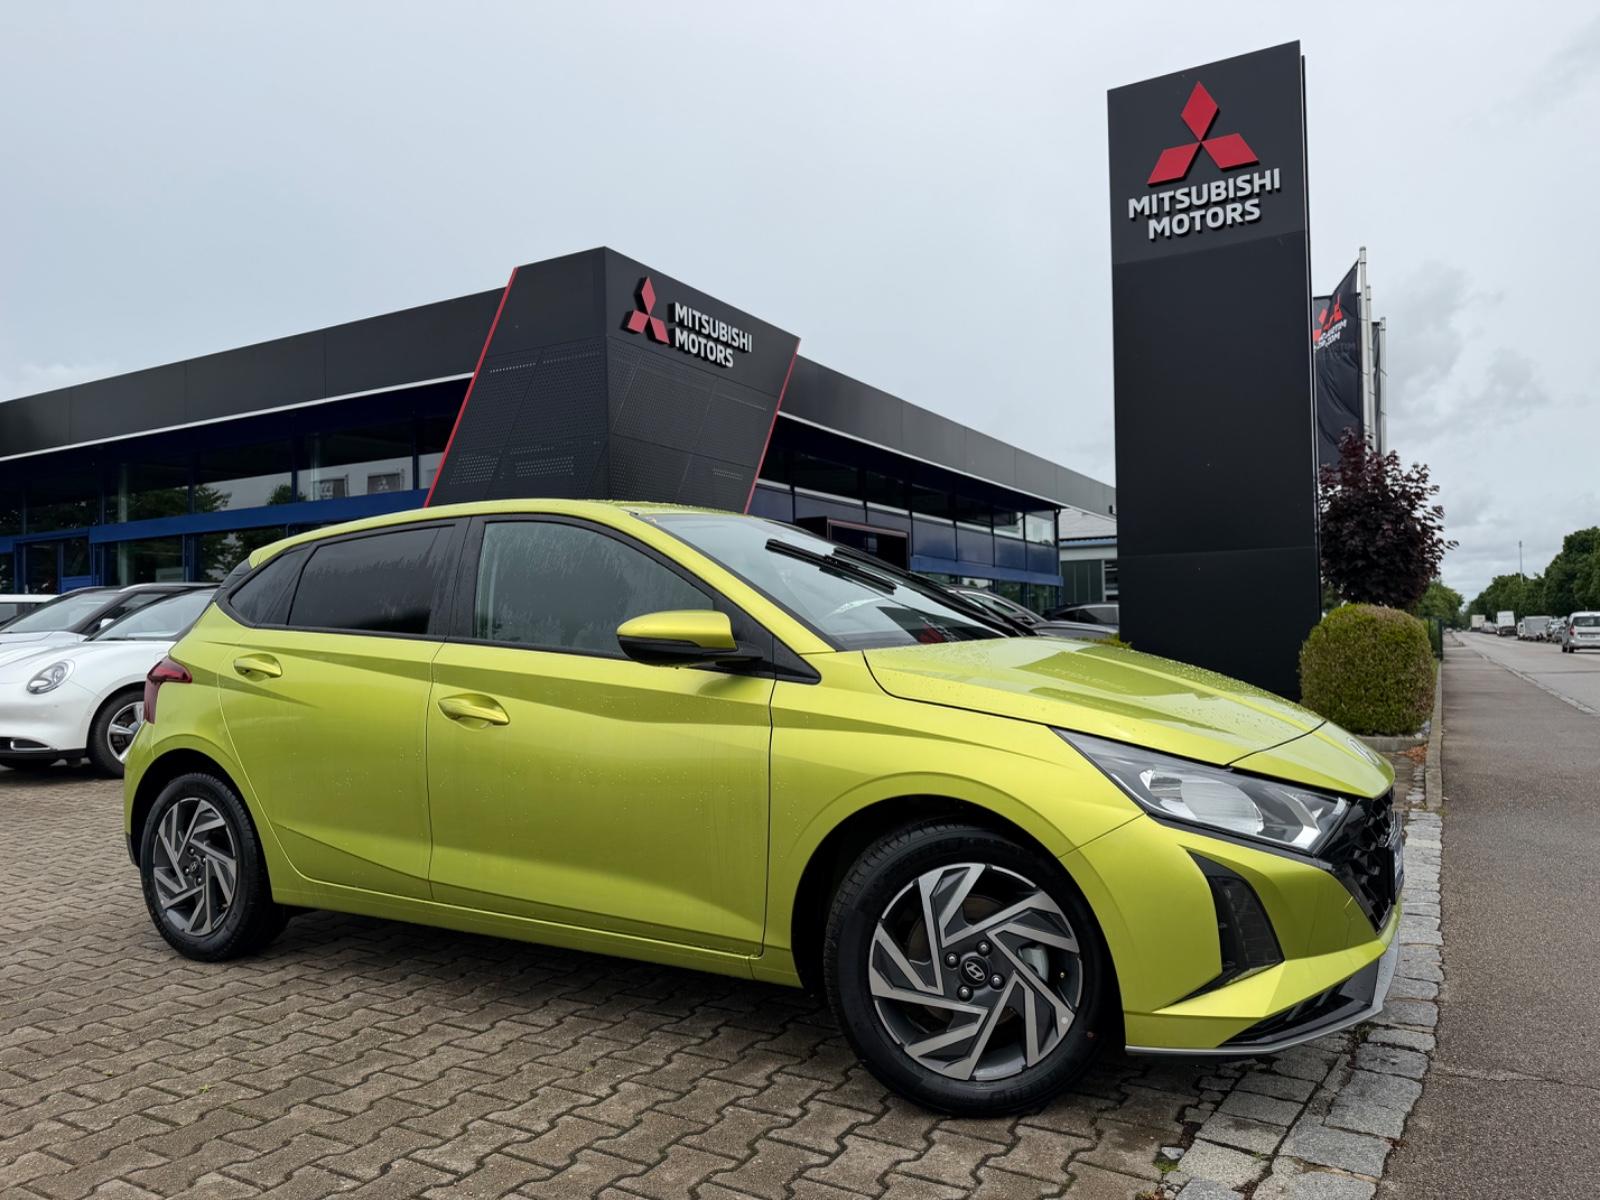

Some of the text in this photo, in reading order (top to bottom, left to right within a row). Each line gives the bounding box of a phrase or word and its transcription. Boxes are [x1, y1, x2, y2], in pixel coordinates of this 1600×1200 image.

[1128, 168, 1281, 219] MITSUBISHI
[1149, 199, 1261, 240] MOTORS
[674, 301, 753, 353] MITSUBISHI
[674, 327, 734, 368] MOTORS
